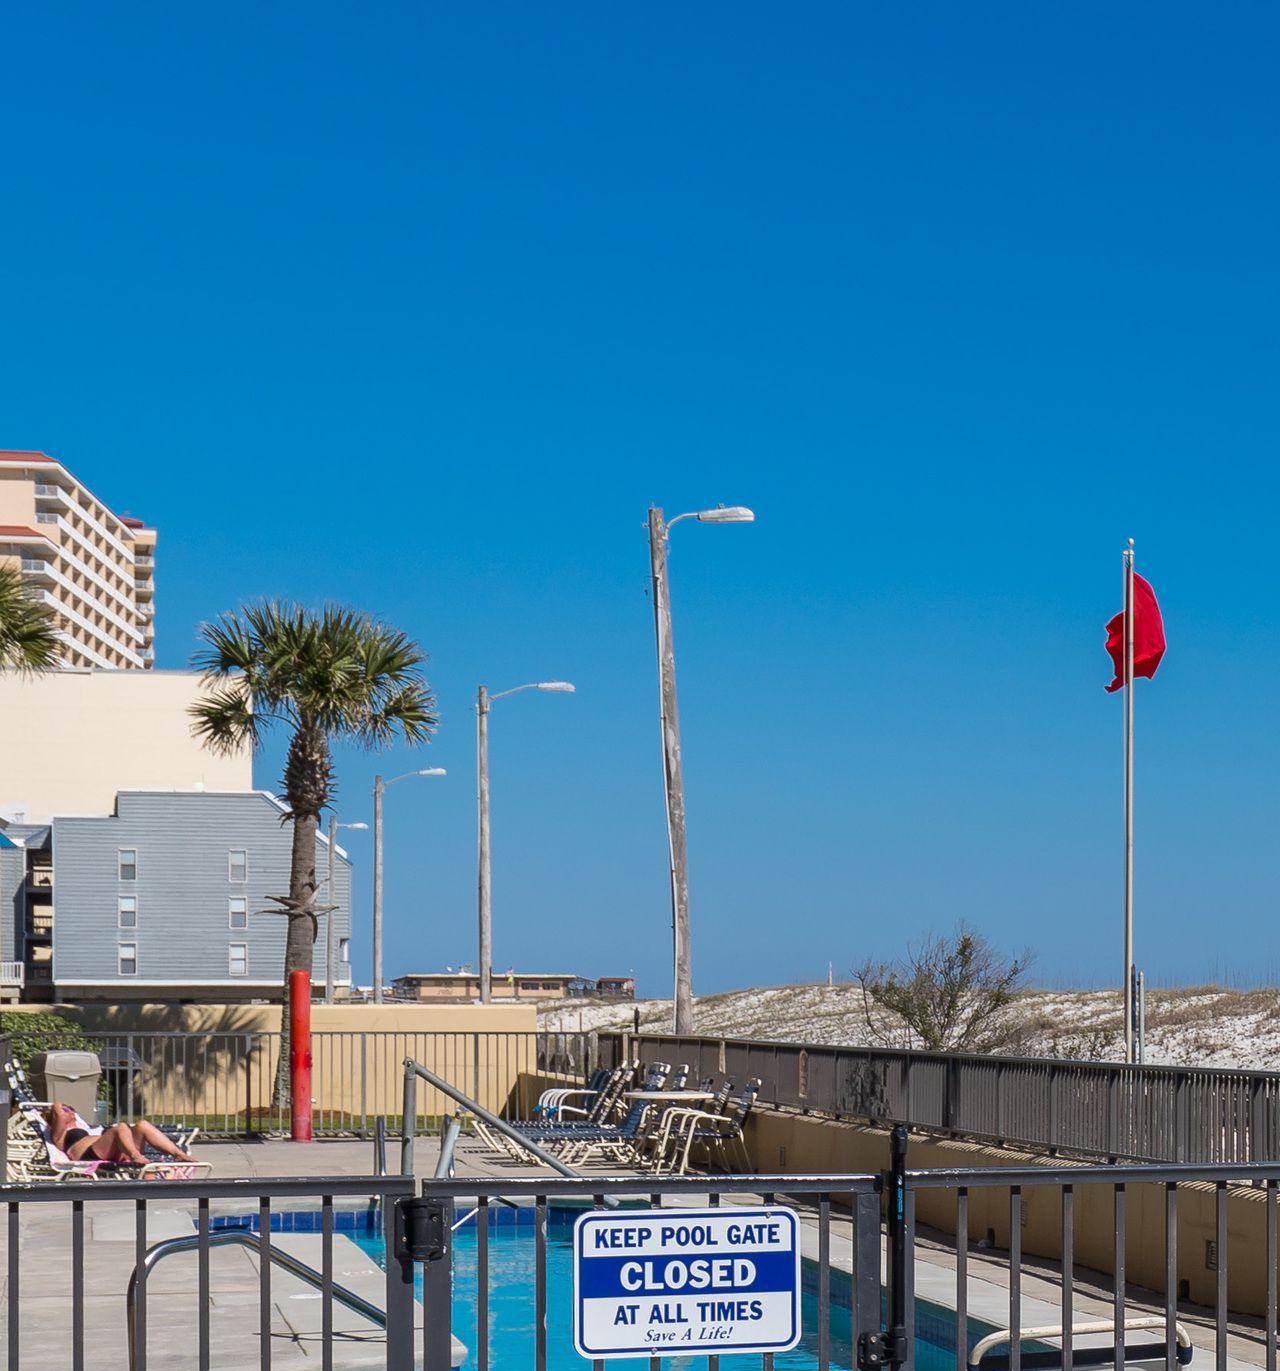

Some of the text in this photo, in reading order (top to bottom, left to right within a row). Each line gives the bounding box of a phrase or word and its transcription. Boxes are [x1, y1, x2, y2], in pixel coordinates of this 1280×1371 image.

[594, 1223, 780, 1249] KEEP POOL GATE
[619, 1258, 757, 1291] CLOSED
[613, 1300, 763, 1325] AT ALL TIMES
[644, 1326, 734, 1343] Save A Life!
